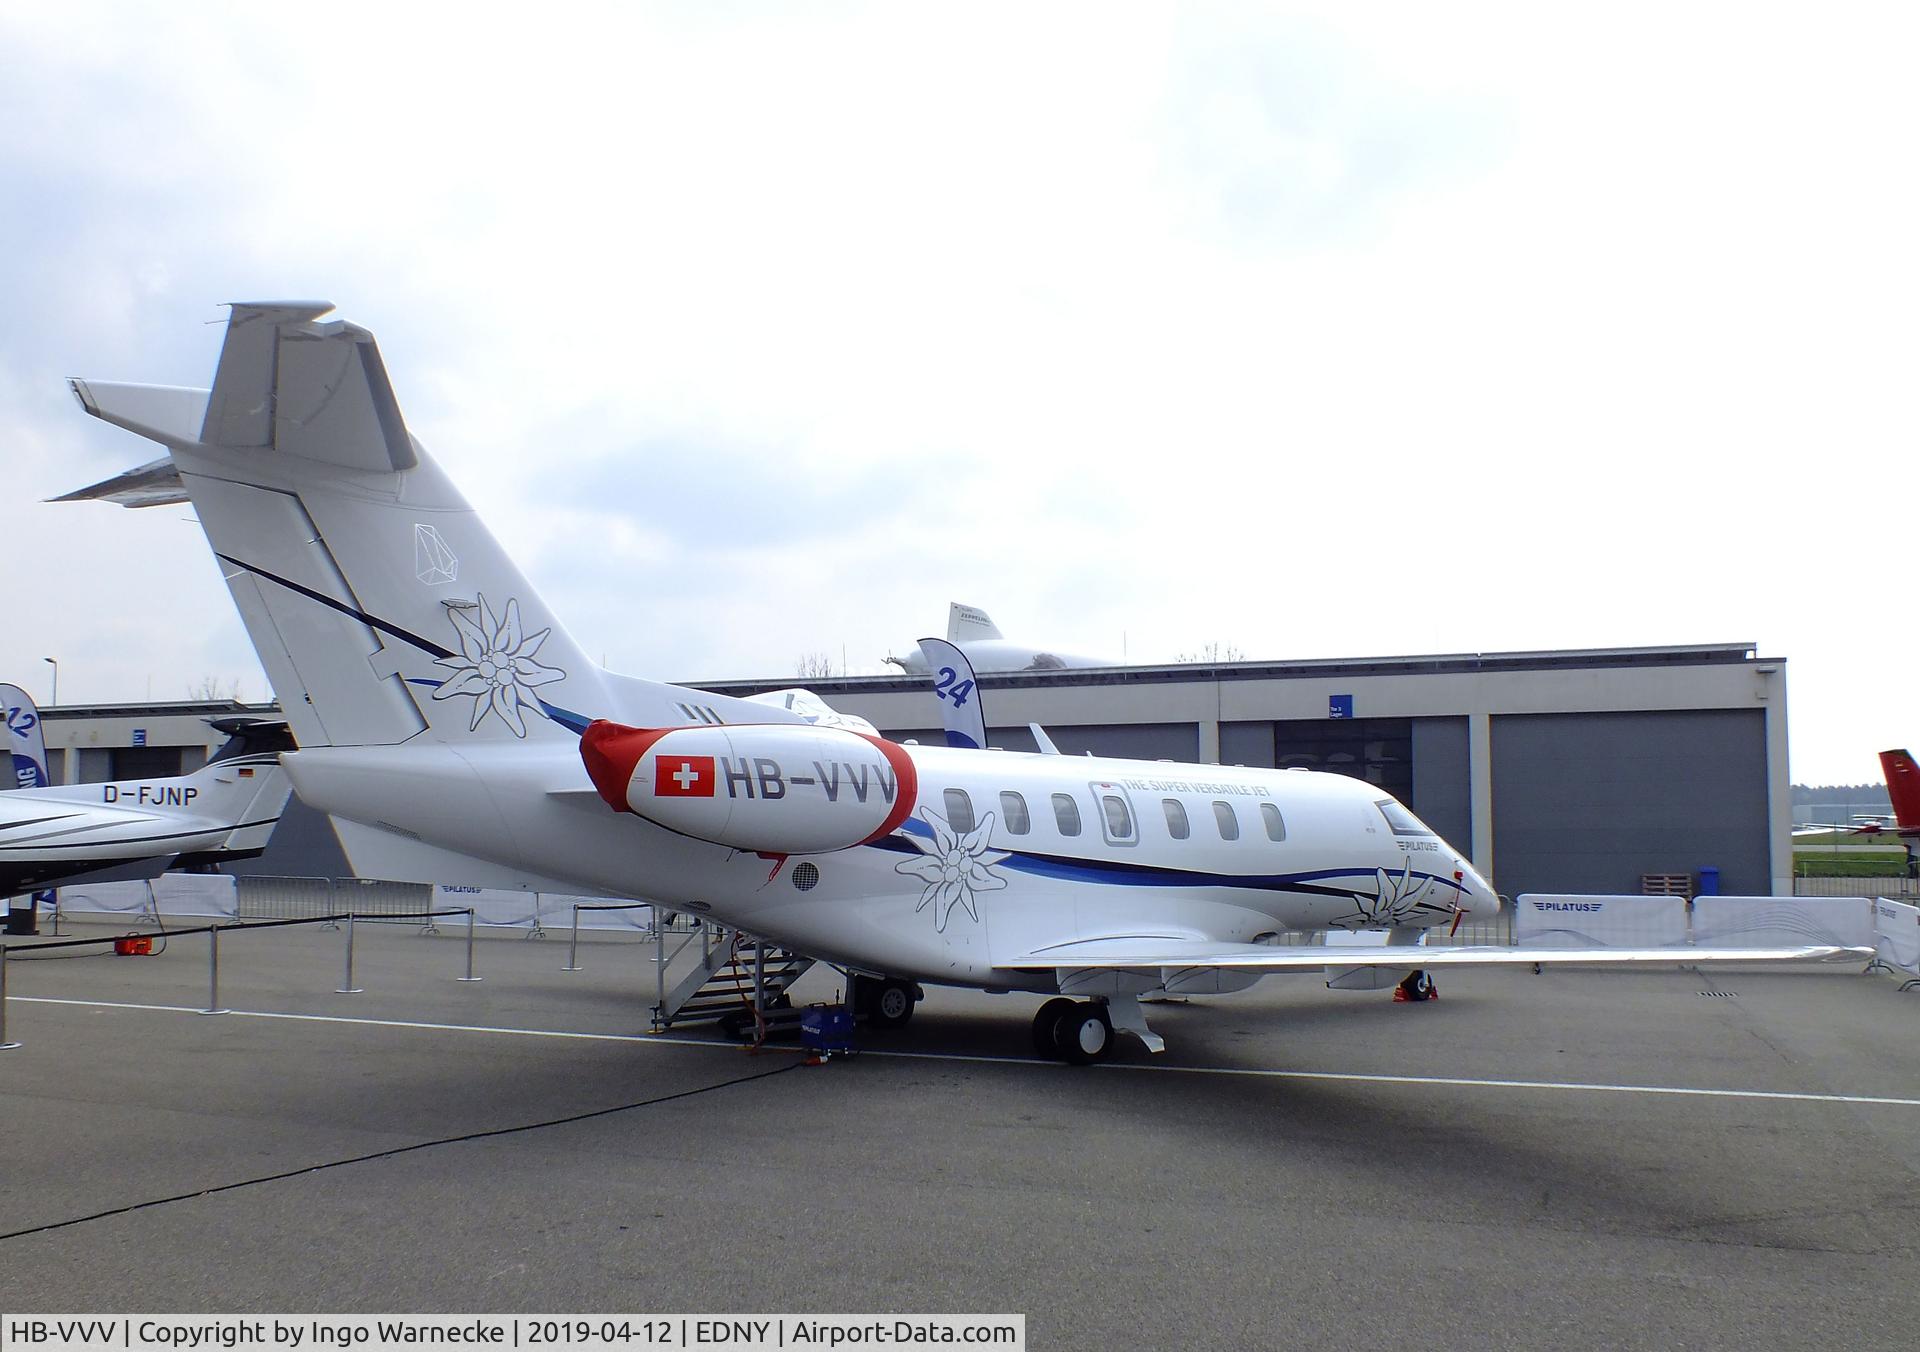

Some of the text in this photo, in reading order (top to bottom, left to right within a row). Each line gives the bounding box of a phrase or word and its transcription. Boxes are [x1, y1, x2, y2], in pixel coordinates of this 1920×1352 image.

[935, 667, 974, 708] 24
[7, 706, 37, 738] 12
[720, 756, 896, 804] HB-VVV
[1121, 779, 1271, 797] THE SUPER VERSATILE JET
[104, 785, 198, 807] D-FJNP
[1405, 841, 1434, 851] PILATUS
[447, 885, 476, 893] PILATUS
[1544, 902, 1591, 912] PILATUS
